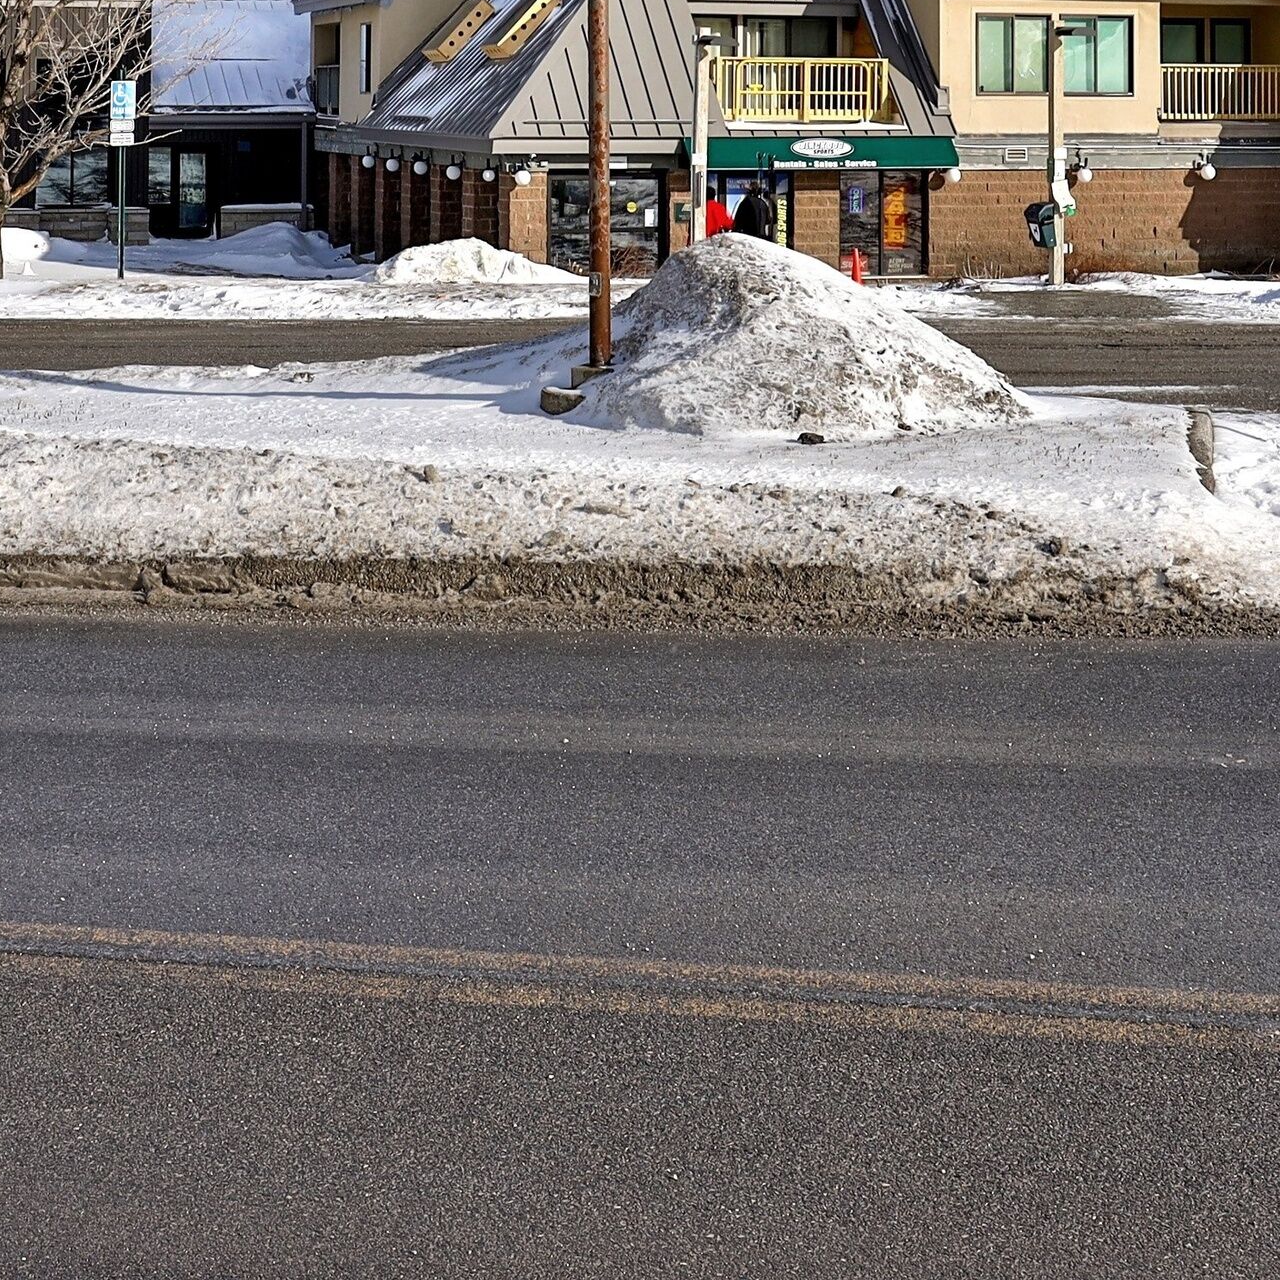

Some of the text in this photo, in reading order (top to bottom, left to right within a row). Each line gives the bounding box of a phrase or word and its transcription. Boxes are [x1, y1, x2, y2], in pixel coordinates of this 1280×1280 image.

[773, 159, 877, 168] Rentals Sales Service
[852, 188, 860, 213] OPEN
[777, 198, 787, 231] SPORTS
